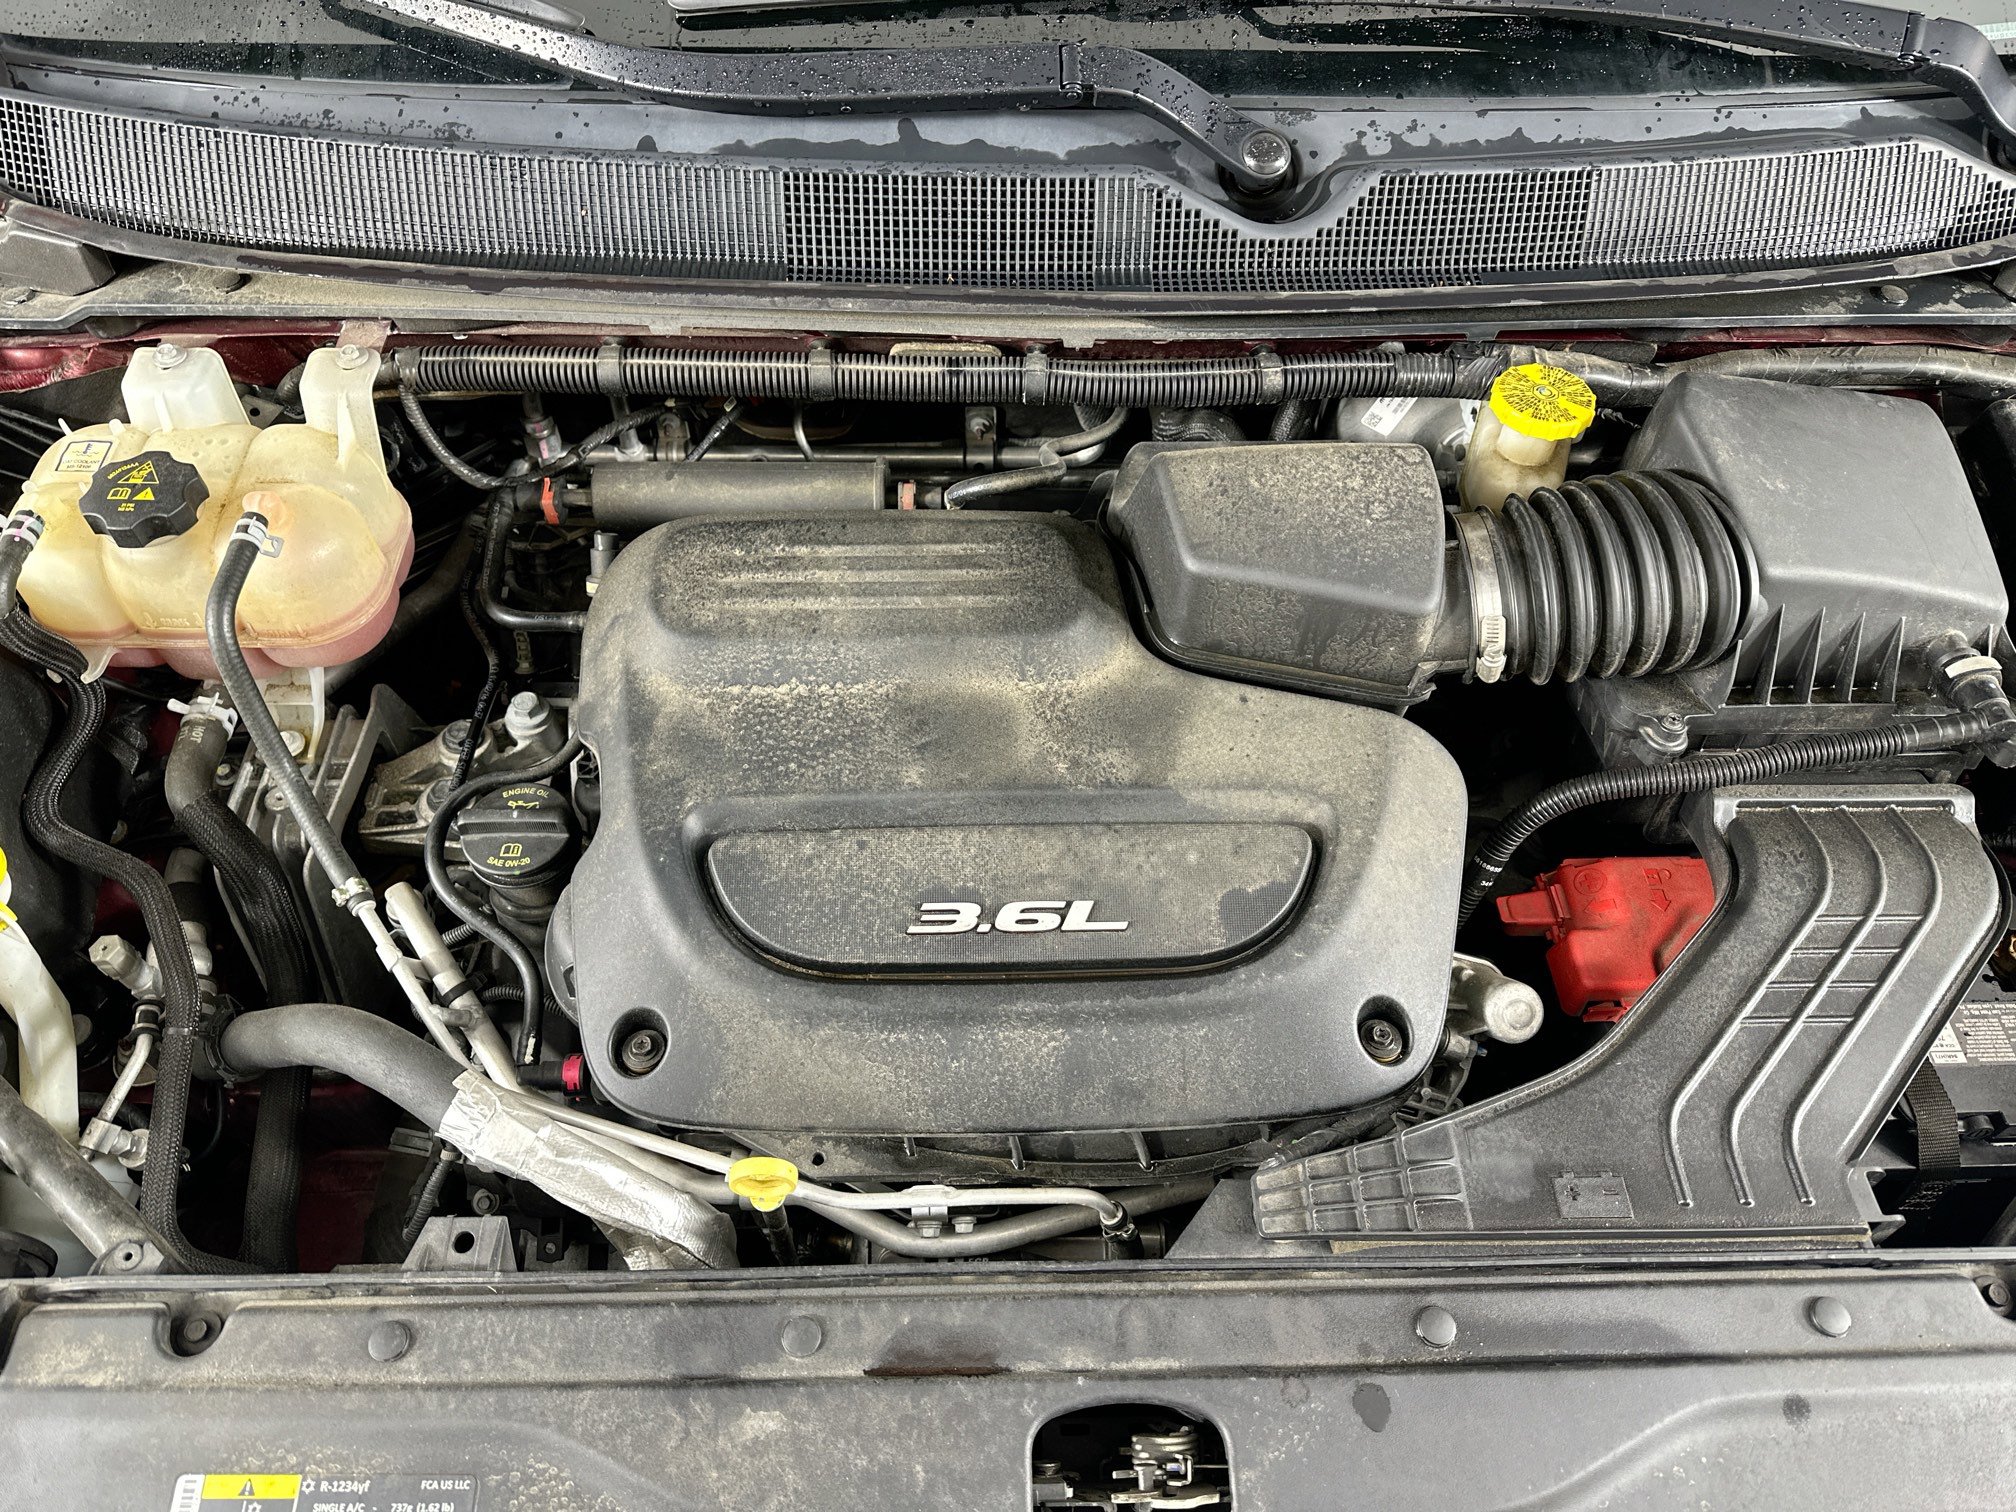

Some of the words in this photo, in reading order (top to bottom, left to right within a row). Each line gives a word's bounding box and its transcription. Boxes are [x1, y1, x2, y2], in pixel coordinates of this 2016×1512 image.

[190, 725, 206, 744] HOT
[502, 787, 535, 798] ENGINE
[536, 788, 550, 799] OIL
[487, 856, 504, 867] SAE
[504, 857, 531, 868] 0W-20
[906, 900, 1129, 935] 3.6L
[320, 1480, 371, 1494] R-1234yf
[420, 1479, 440, 1490] FCA
[440, 1479, 454, 1490] US
[454, 1479, 471, 1490] LLC
[312, 1503, 346, 1512] SINGLE
[346, 1503, 366, 1512] A/C
[416, 1502, 440, 1512] (1.62
[441, 1502, 455, 1512] lb)
